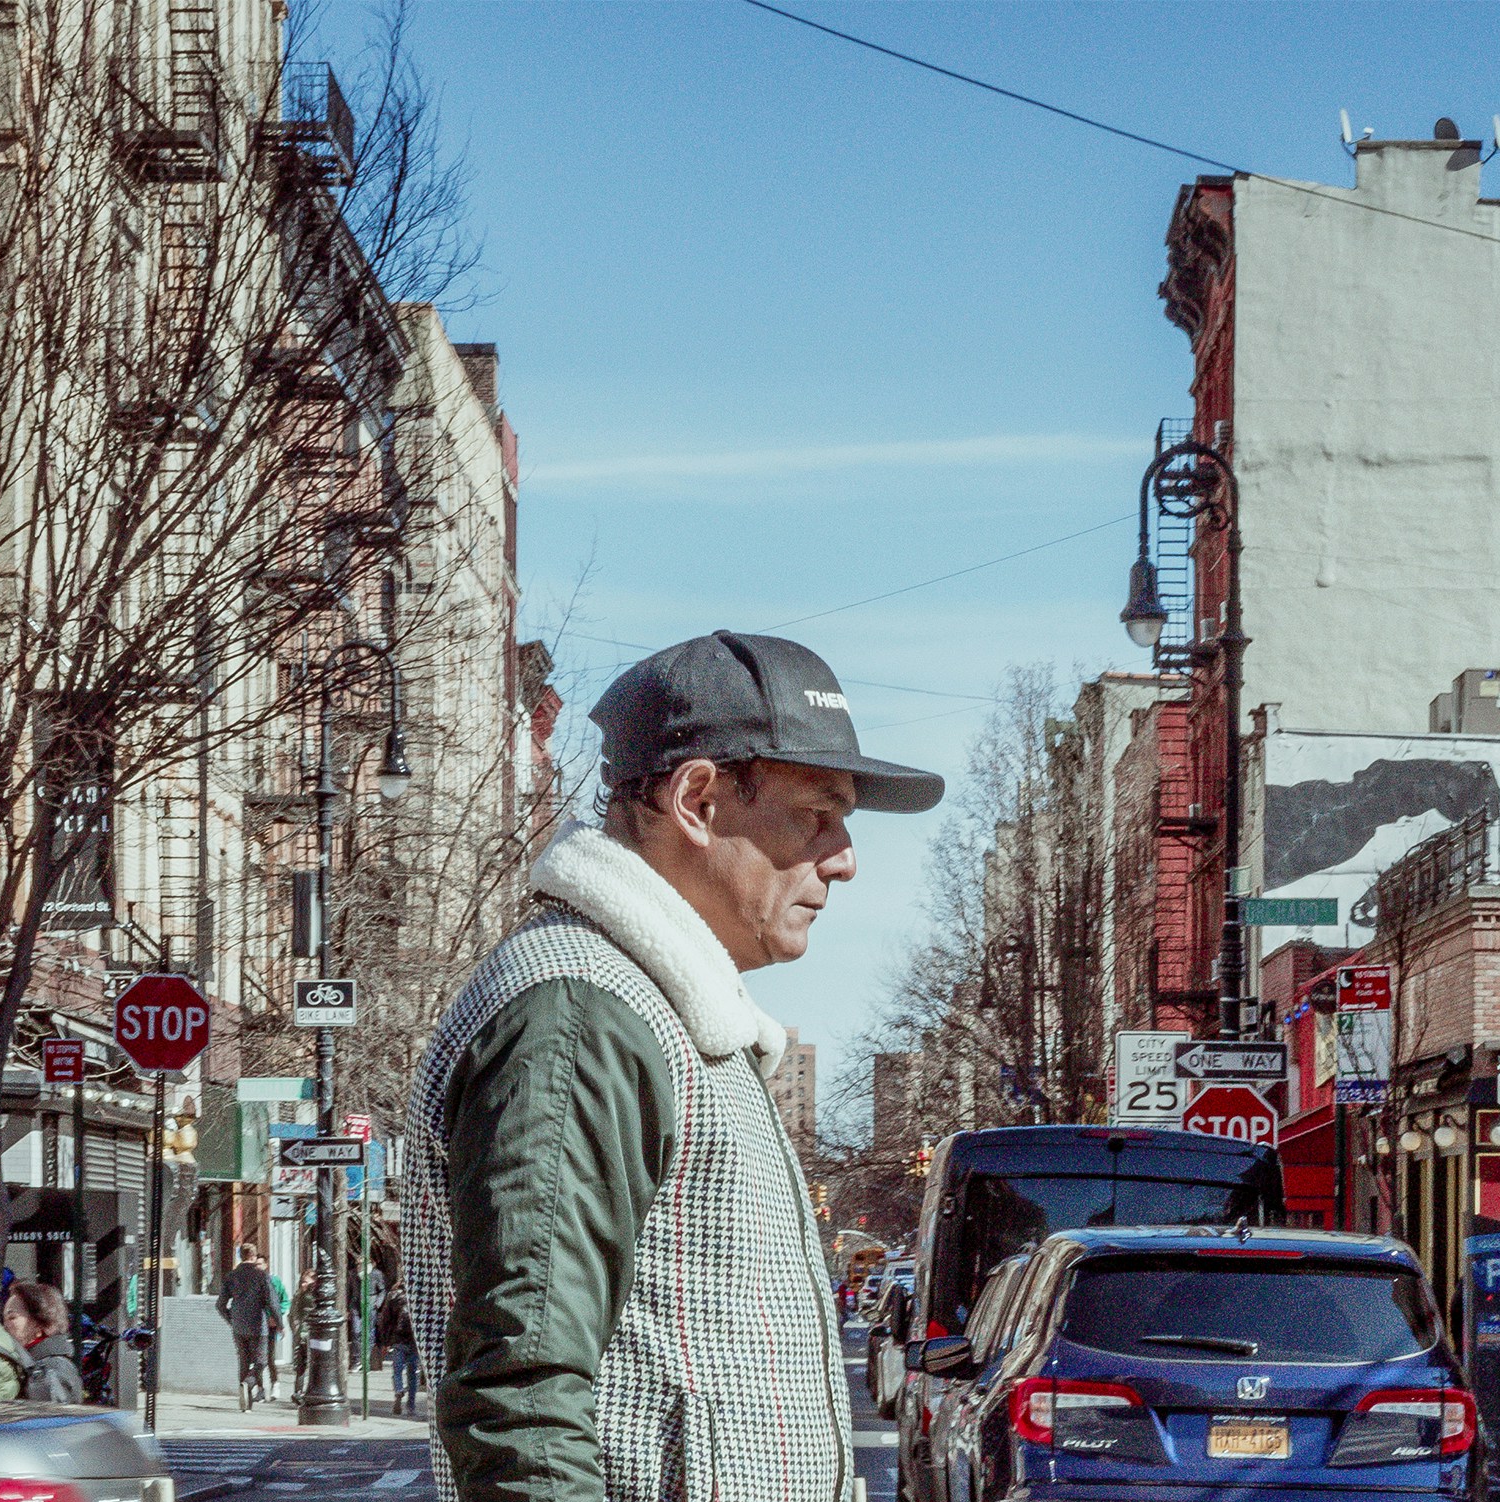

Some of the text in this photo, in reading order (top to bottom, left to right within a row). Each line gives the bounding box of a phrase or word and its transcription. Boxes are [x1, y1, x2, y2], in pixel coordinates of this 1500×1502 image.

[299, 1009, 352, 1021] BIKE LANE
[121, 1004, 206, 1041] STOP
[1137, 1038, 1167, 1049] CITY
[1131, 1052, 1172, 1062] SPEED
[1188, 1053, 1277, 1068] ONE WAY
[1135, 1066, 1168, 1076] LIMIT
[1127, 1081, 1178, 1111] 25
[1187, 1115, 1271, 1146] STOP
[291, 1147, 354, 1158] ONE WAY
[279, 1169, 314, 1183] ATM
[1062, 1437, 1118, 1449] PILOT
[1391, 1445, 1433, 1457] AWD
